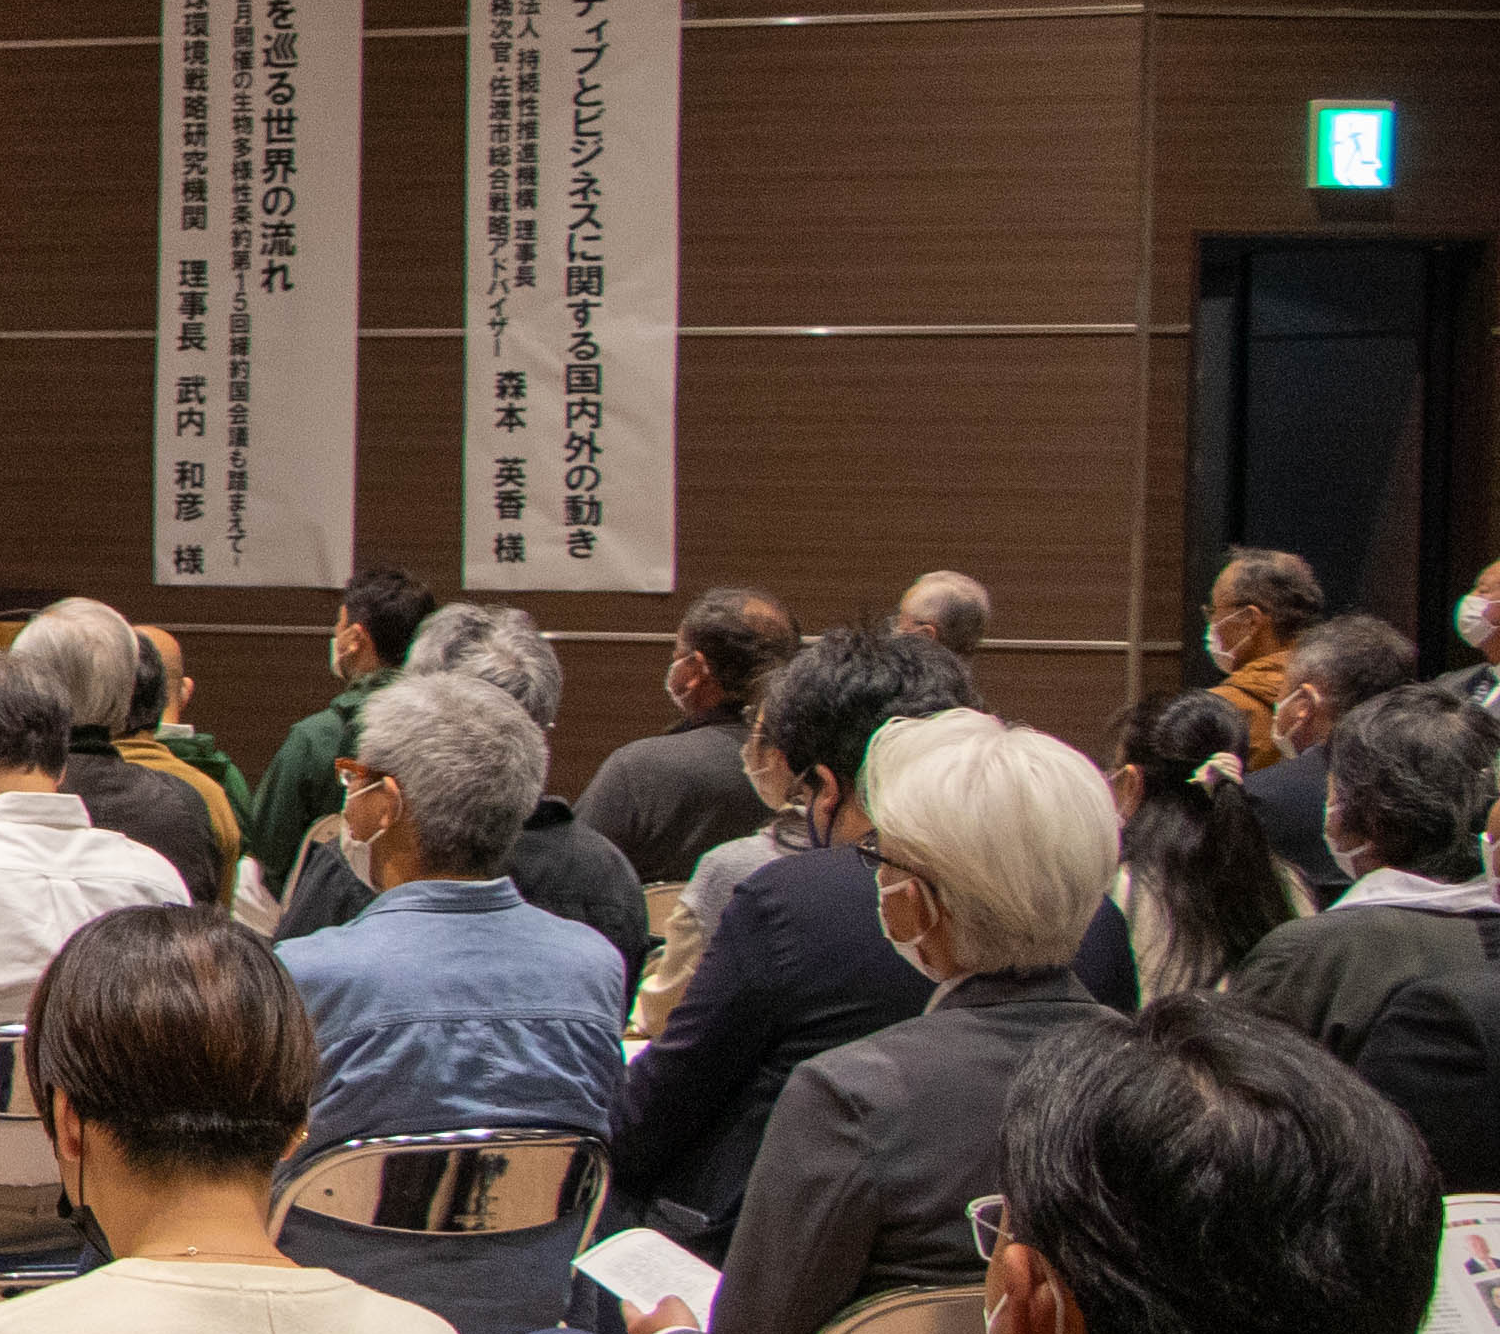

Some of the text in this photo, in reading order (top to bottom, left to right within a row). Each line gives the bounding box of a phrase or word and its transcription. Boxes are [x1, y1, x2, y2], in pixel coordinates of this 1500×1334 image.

[514, 219, 538, 288] 理事長
[177, 259, 208, 352] 理事長
[174, 374, 207, 437] 武内
[174, 460, 205, 522] 和彦
[494, 370, 527, 563] 森本 英香 様
[173, 544, 205, 576] 様
